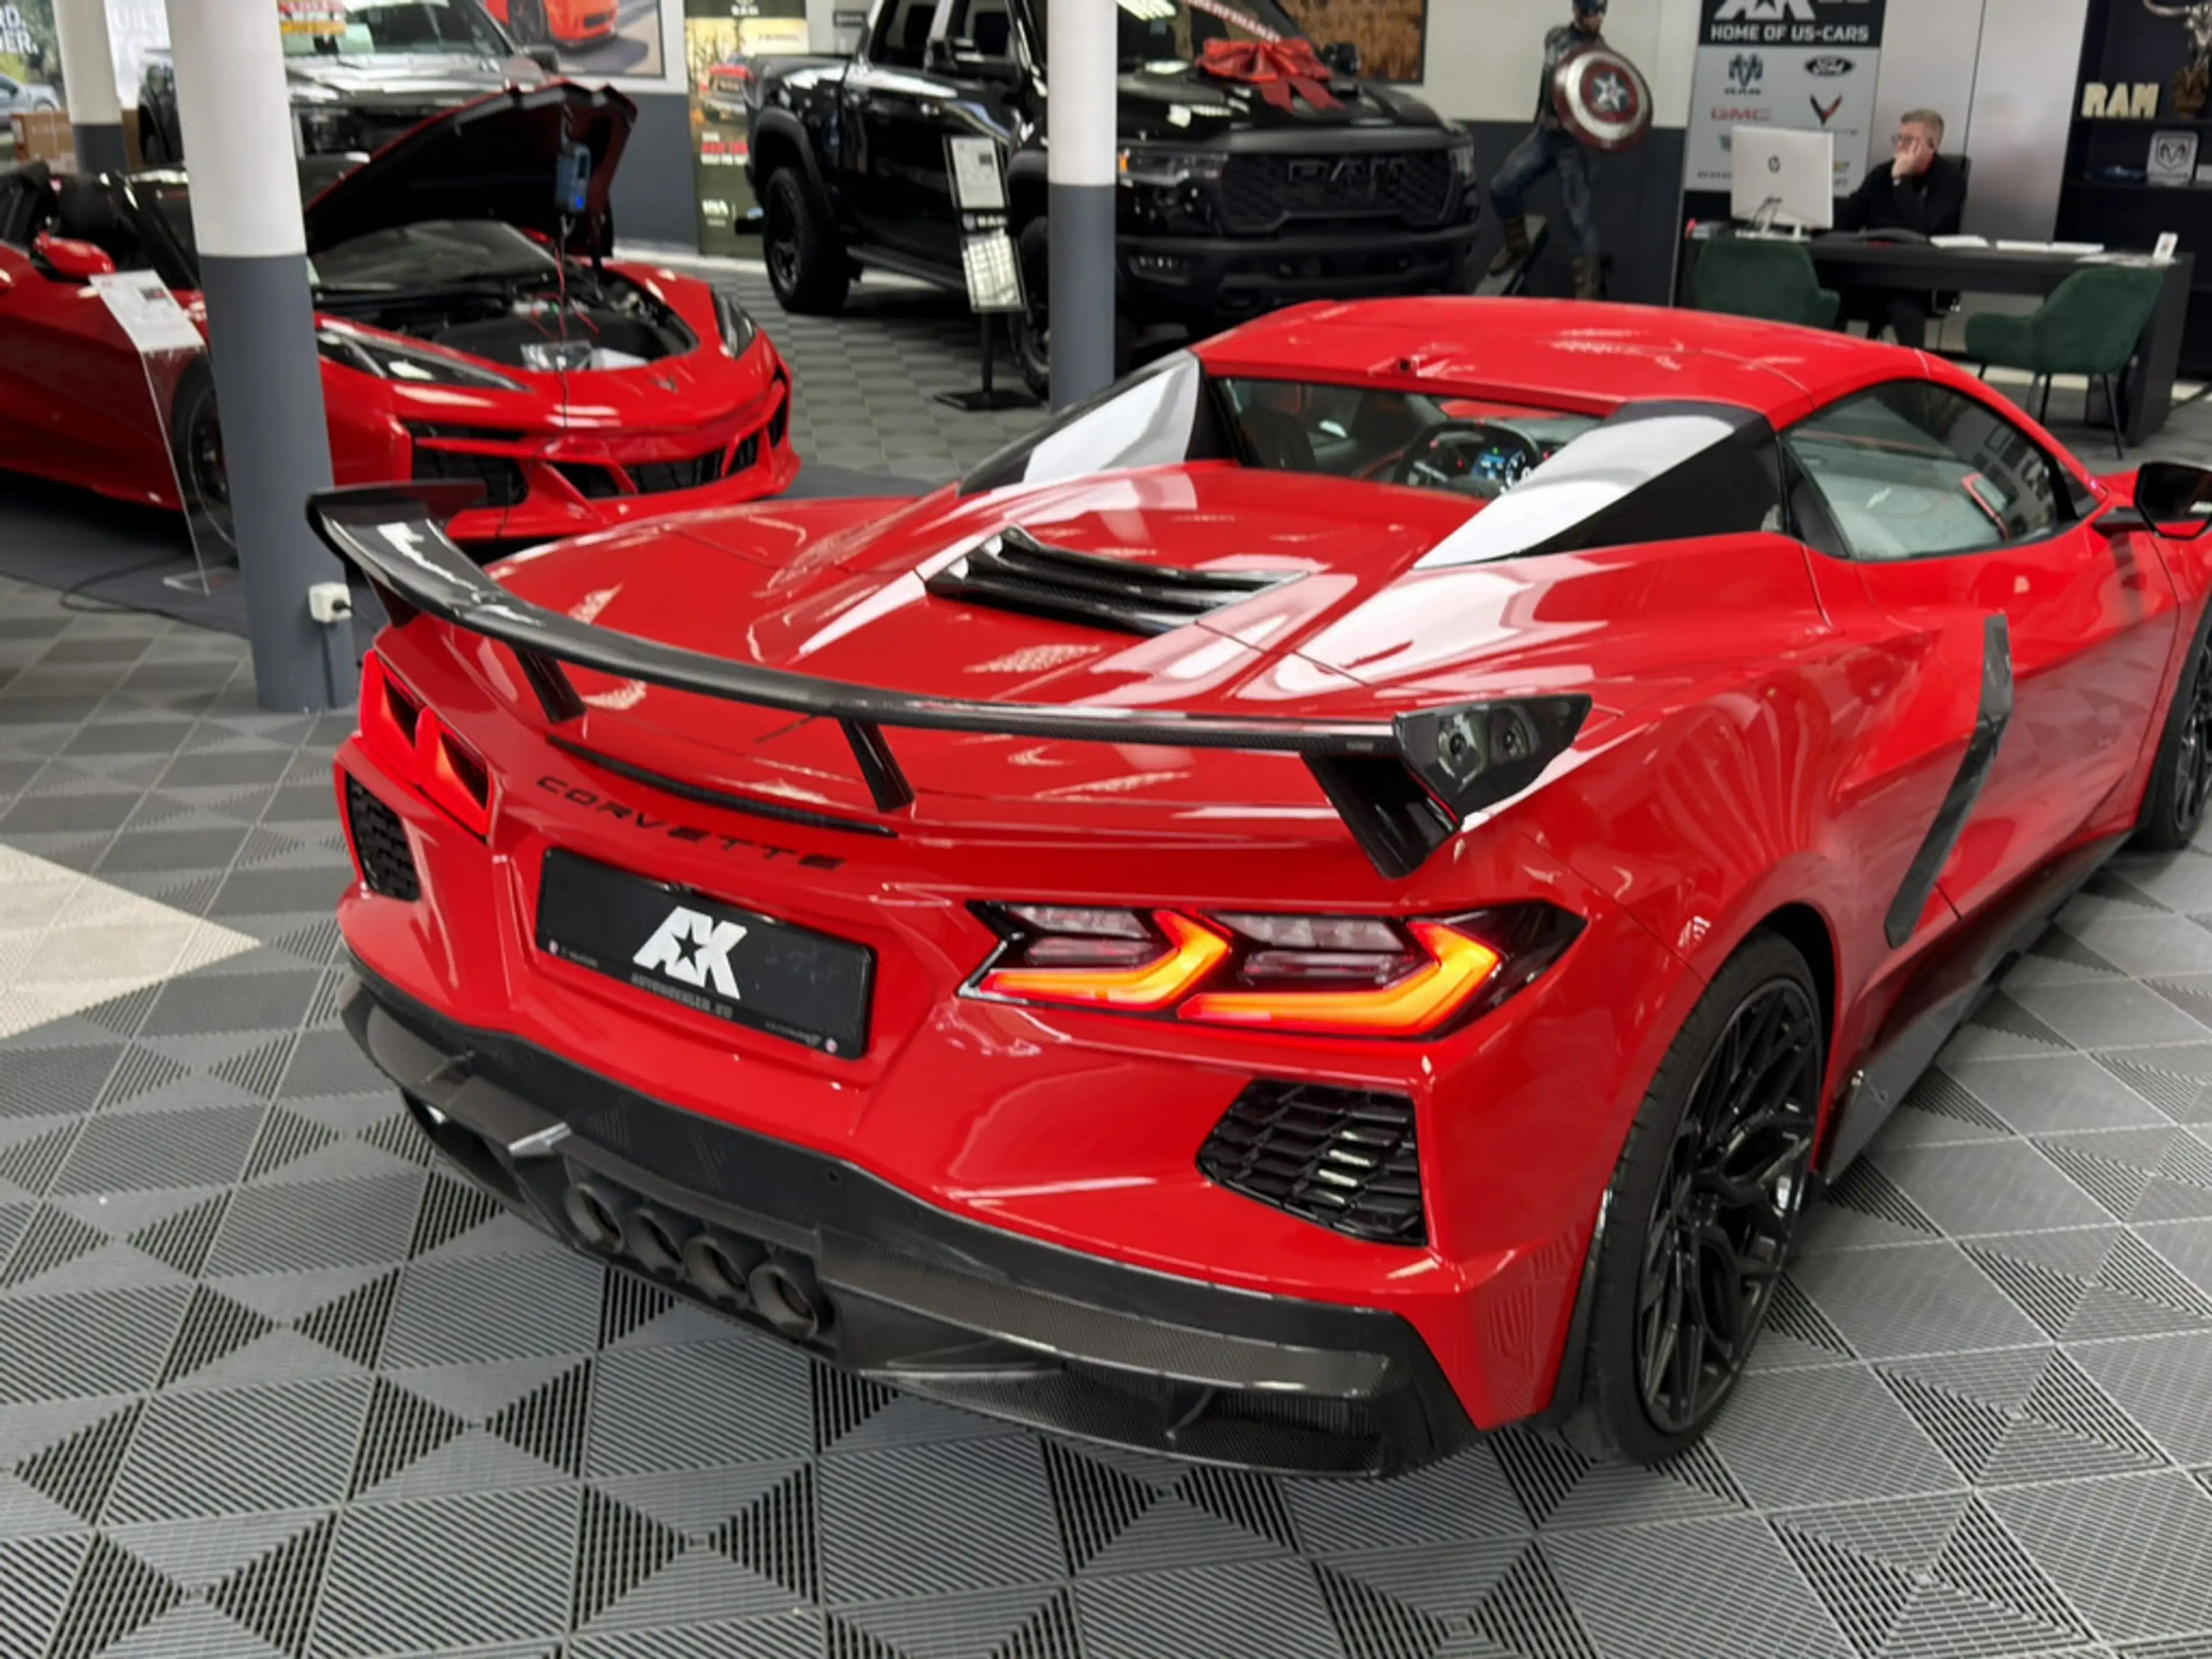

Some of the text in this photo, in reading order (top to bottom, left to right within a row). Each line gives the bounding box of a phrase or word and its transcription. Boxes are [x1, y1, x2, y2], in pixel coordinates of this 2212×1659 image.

[1711, 24, 1869, 43] HOME OF US-CARS
[1710, 107, 1770, 121] GMC
[2082, 82, 2160, 119] RAM
[536, 775, 847, 871] CORVETTE
[632, 905, 748, 1001] AK
